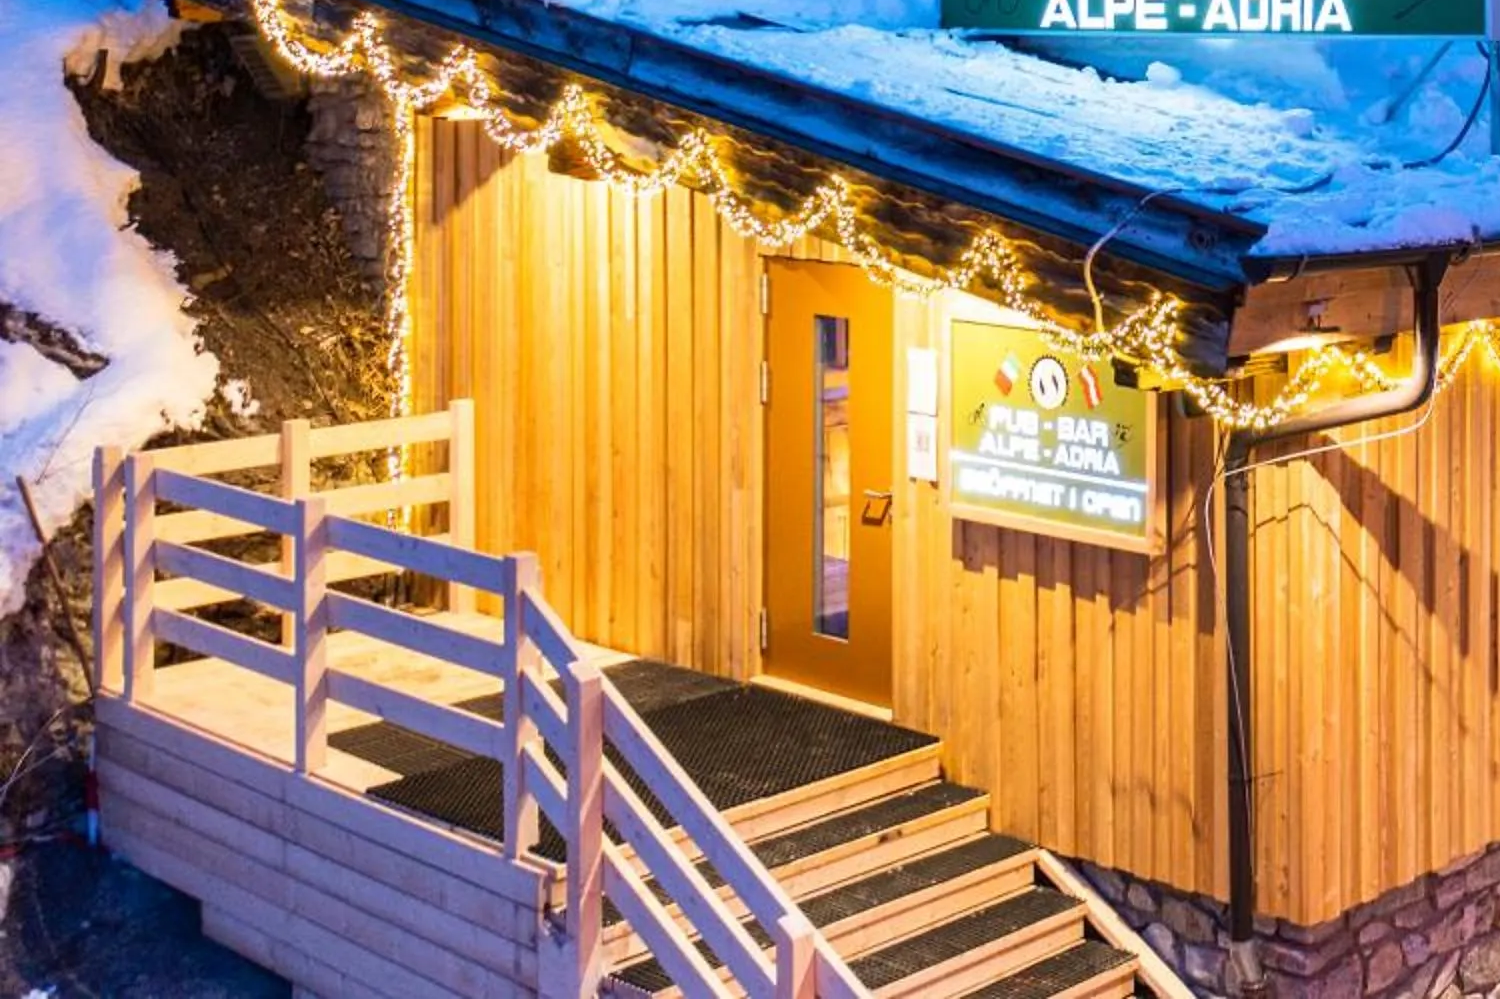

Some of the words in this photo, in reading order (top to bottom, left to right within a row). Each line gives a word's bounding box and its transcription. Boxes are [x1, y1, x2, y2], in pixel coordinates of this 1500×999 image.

[988, 405, 1039, 436] PUB
[1057, 416, 1109, 447] BAR
[979, 431, 1040, 461] ALPE
[1054, 443, 1120, 475] ADRIA
